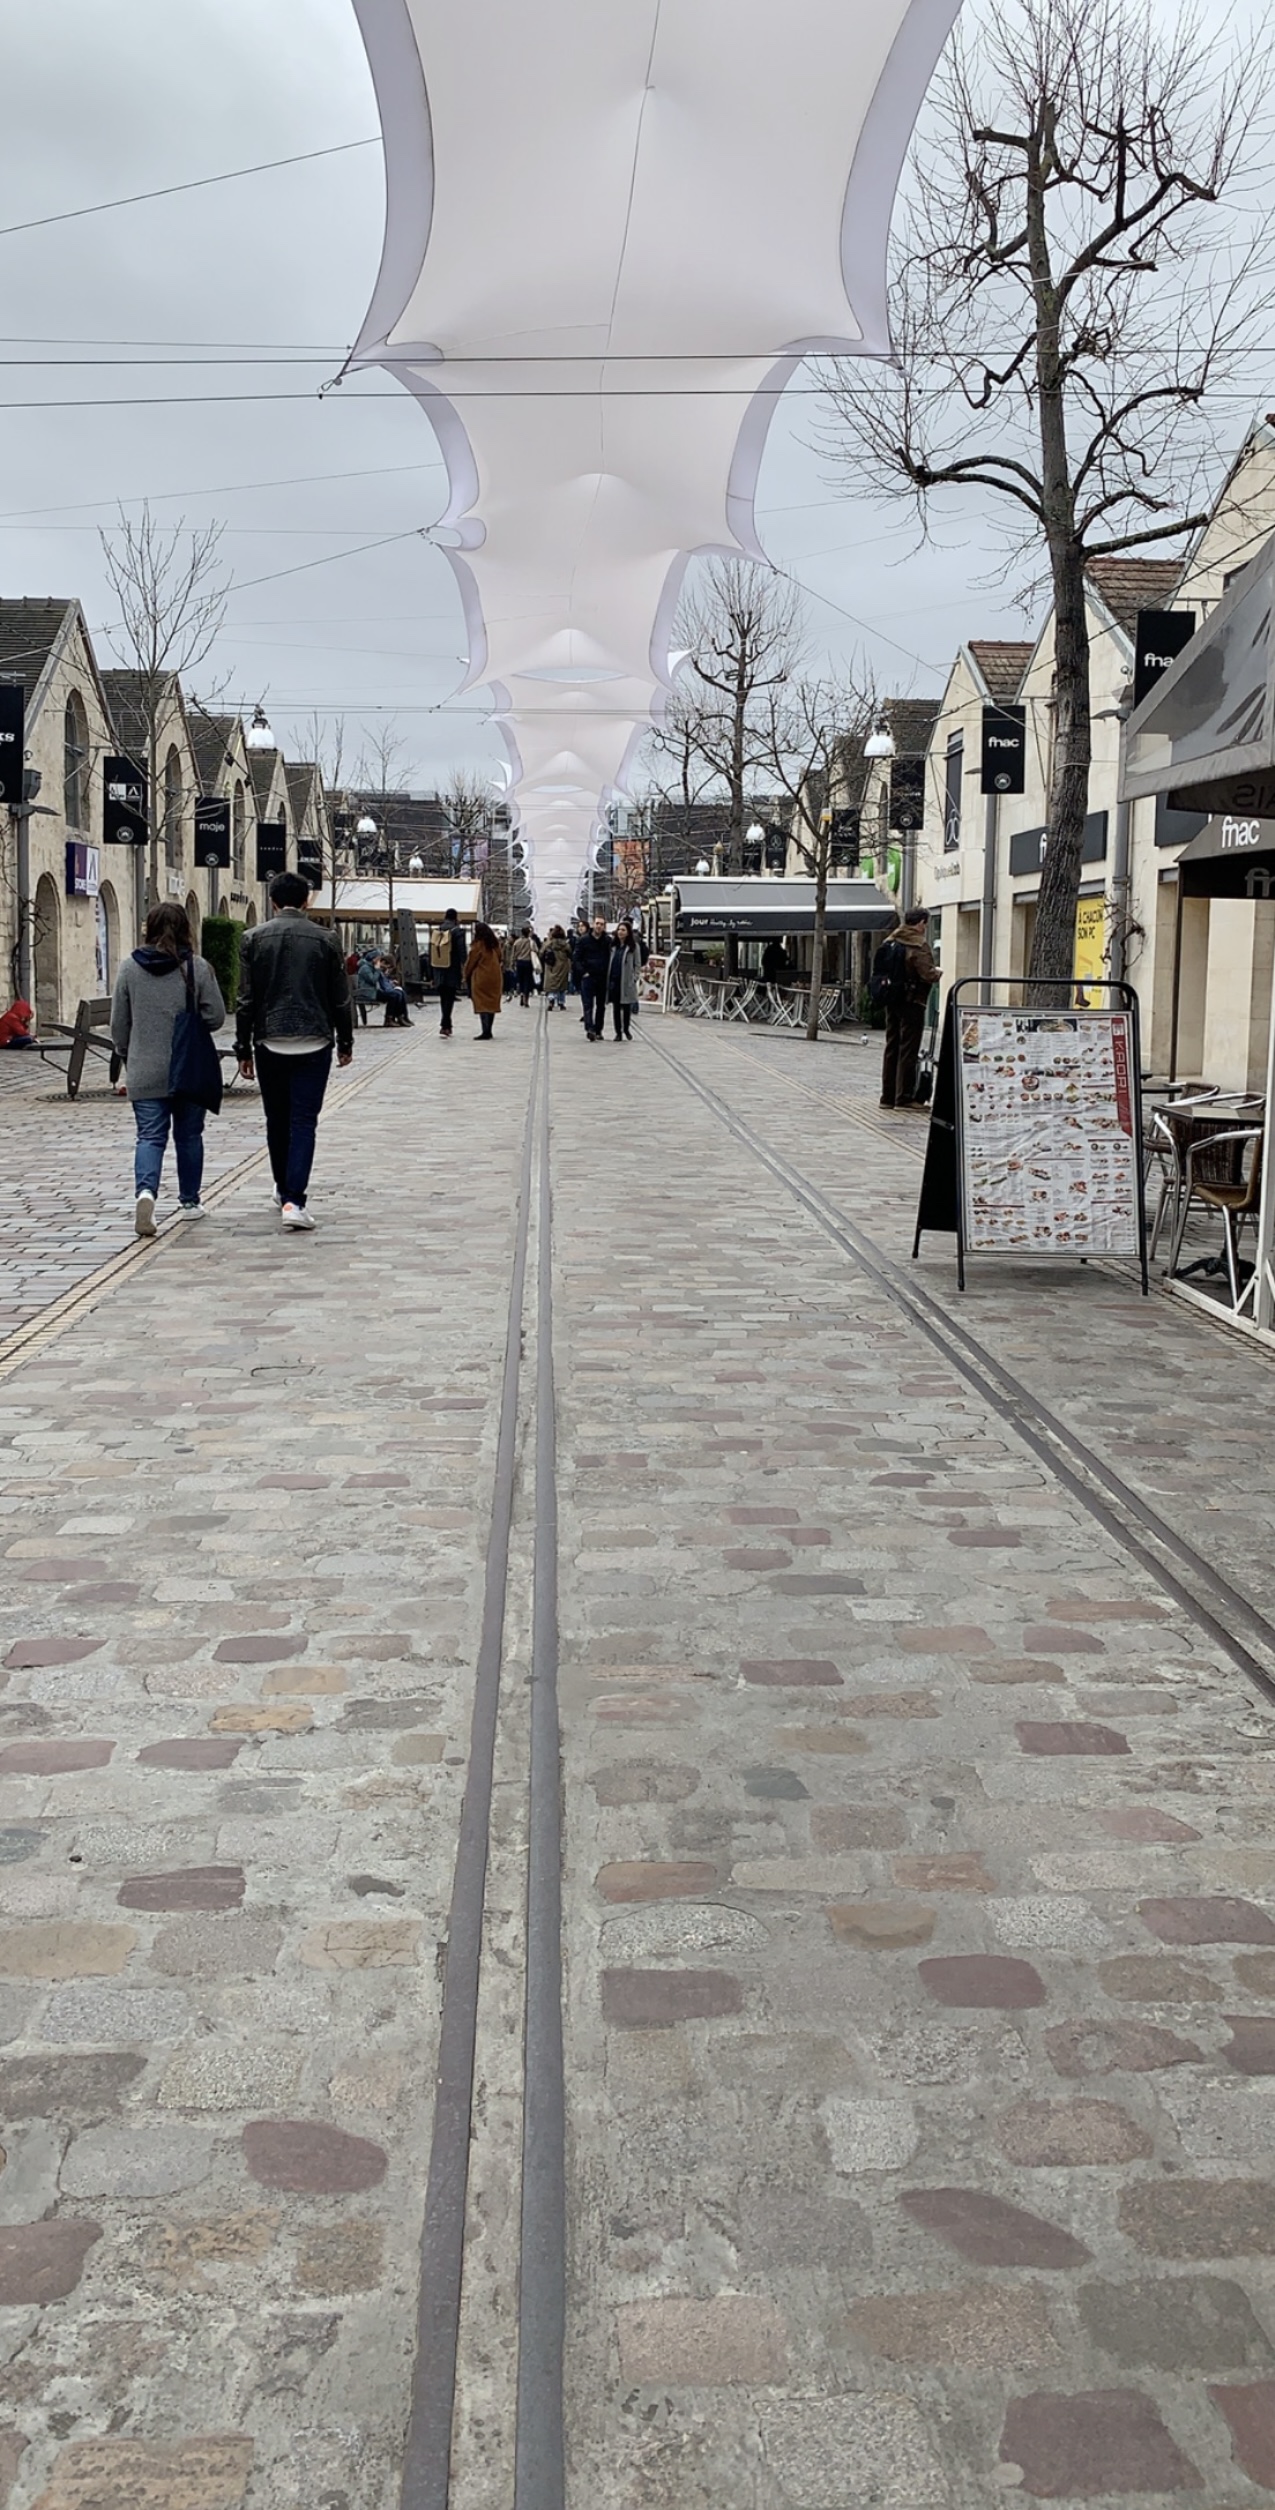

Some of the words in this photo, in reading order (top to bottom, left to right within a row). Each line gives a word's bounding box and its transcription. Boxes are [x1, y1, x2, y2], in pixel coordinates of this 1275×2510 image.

[1143, 652, 1175, 668] fna
[987, 735, 1020, 748] fnac
[1221, 815, 1260, 849] fnac
